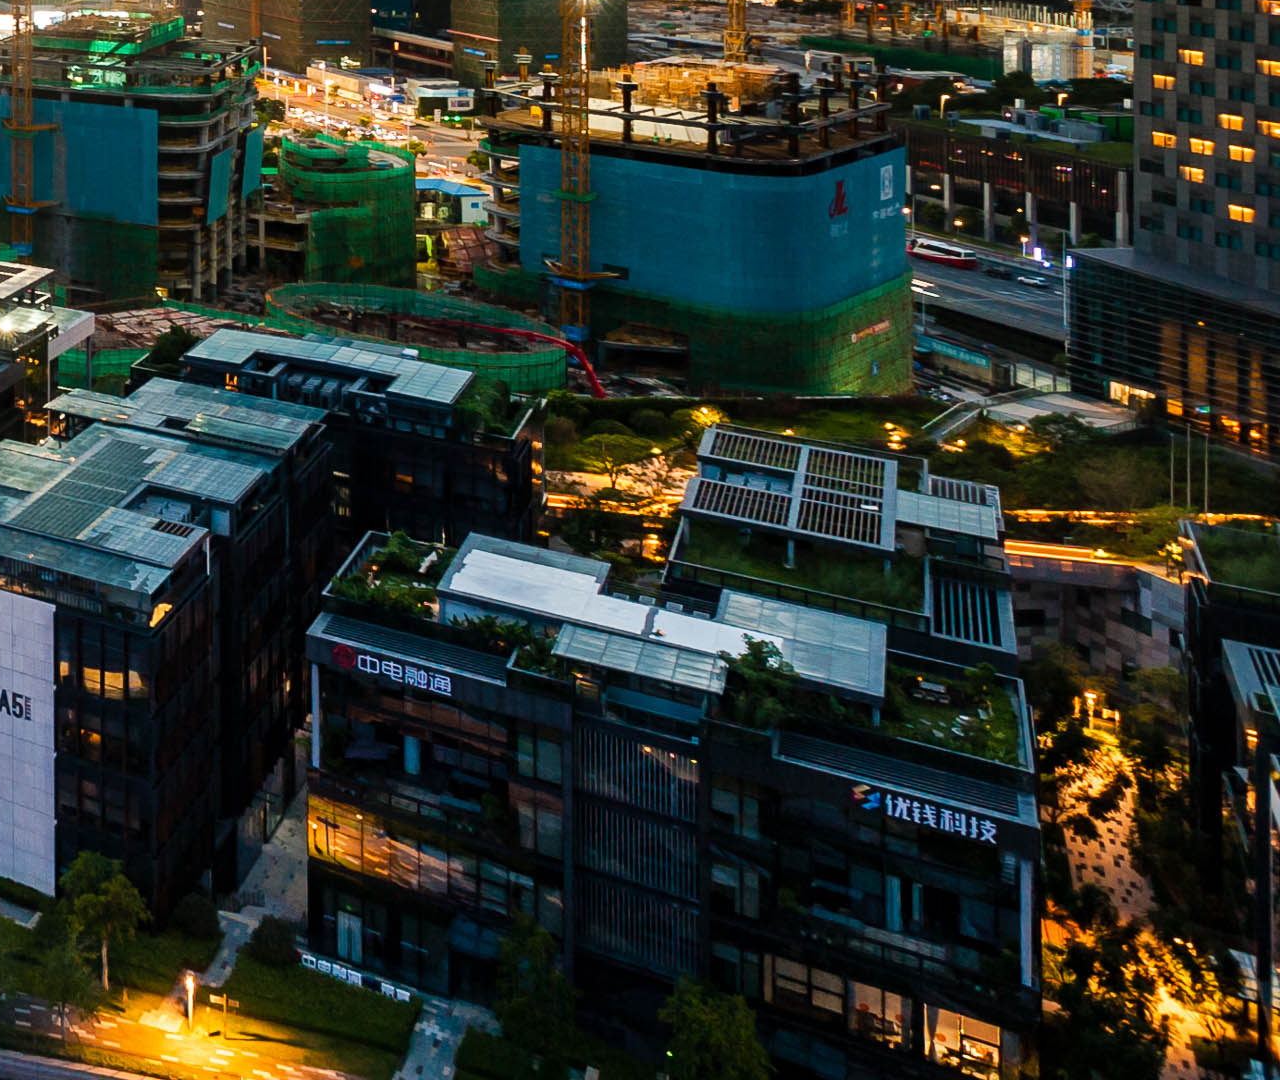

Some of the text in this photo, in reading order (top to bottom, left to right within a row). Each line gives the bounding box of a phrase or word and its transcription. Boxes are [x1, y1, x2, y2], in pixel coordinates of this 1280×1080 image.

[357, 654, 452, 696] 中电融通
[885, 793, 997, 845] 优钱科技
